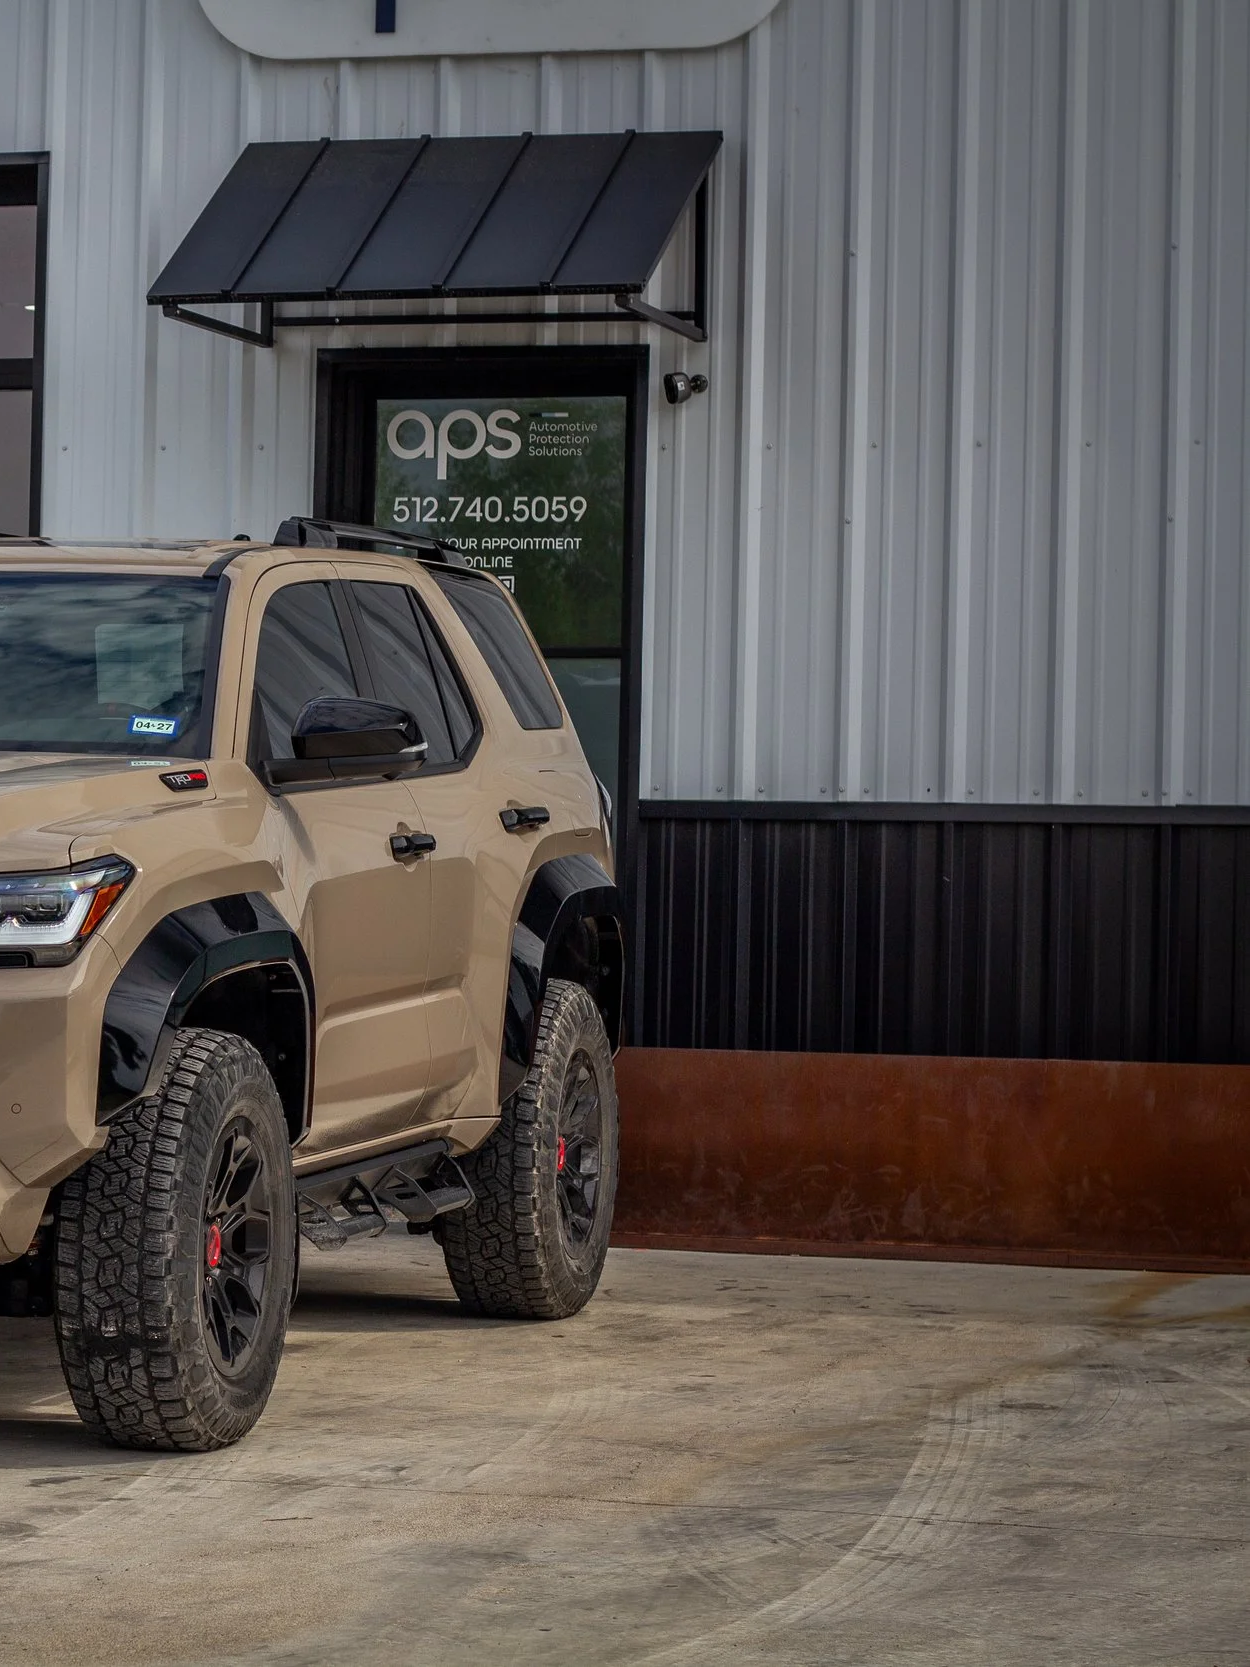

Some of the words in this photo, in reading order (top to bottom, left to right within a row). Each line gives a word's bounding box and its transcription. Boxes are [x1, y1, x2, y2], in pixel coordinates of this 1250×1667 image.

[528, 421, 598, 432] Automotive
[387, 409, 522, 481] aps
[528, 433, 590, 445] Protection
[528, 446, 583, 457] Solutions
[392, 496, 588, 523] 512.740.5059
[481, 537, 582, 550] APPOINTMENT
